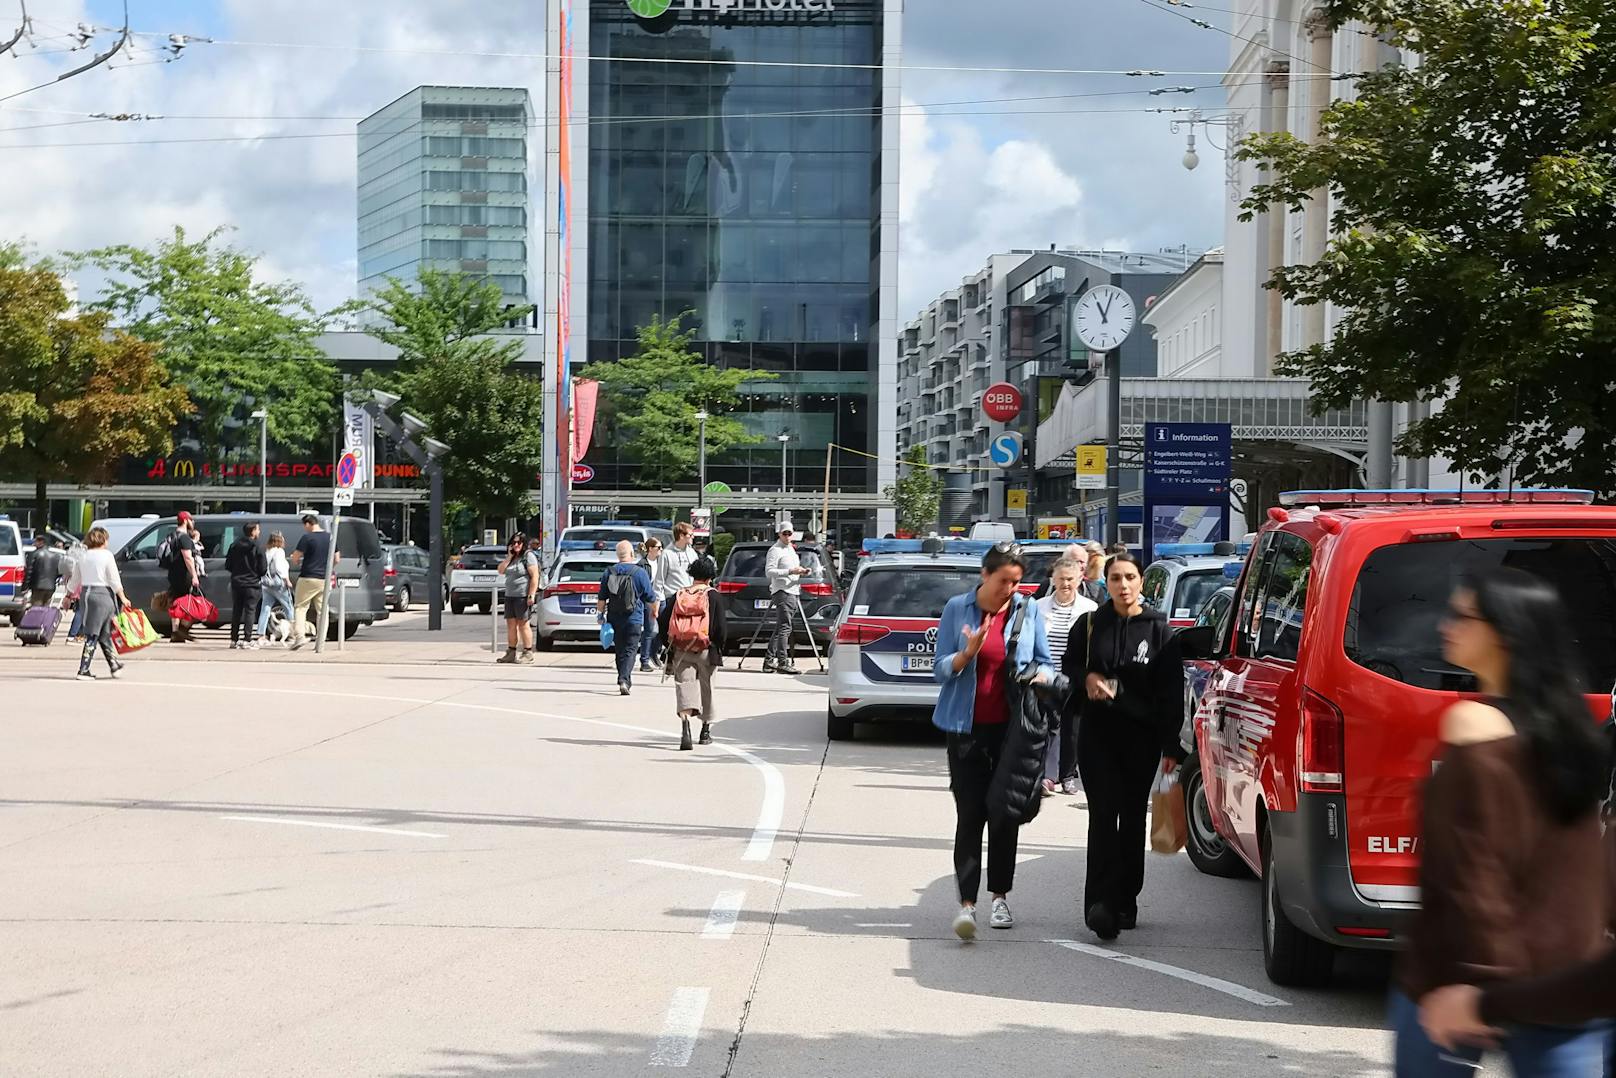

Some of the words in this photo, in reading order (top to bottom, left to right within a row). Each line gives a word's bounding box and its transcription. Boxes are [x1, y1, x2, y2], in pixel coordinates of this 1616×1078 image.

[986, 393, 1013, 404] ÖBB
[1172, 433, 1219, 441] Information
[994, 435, 1014, 468] S
